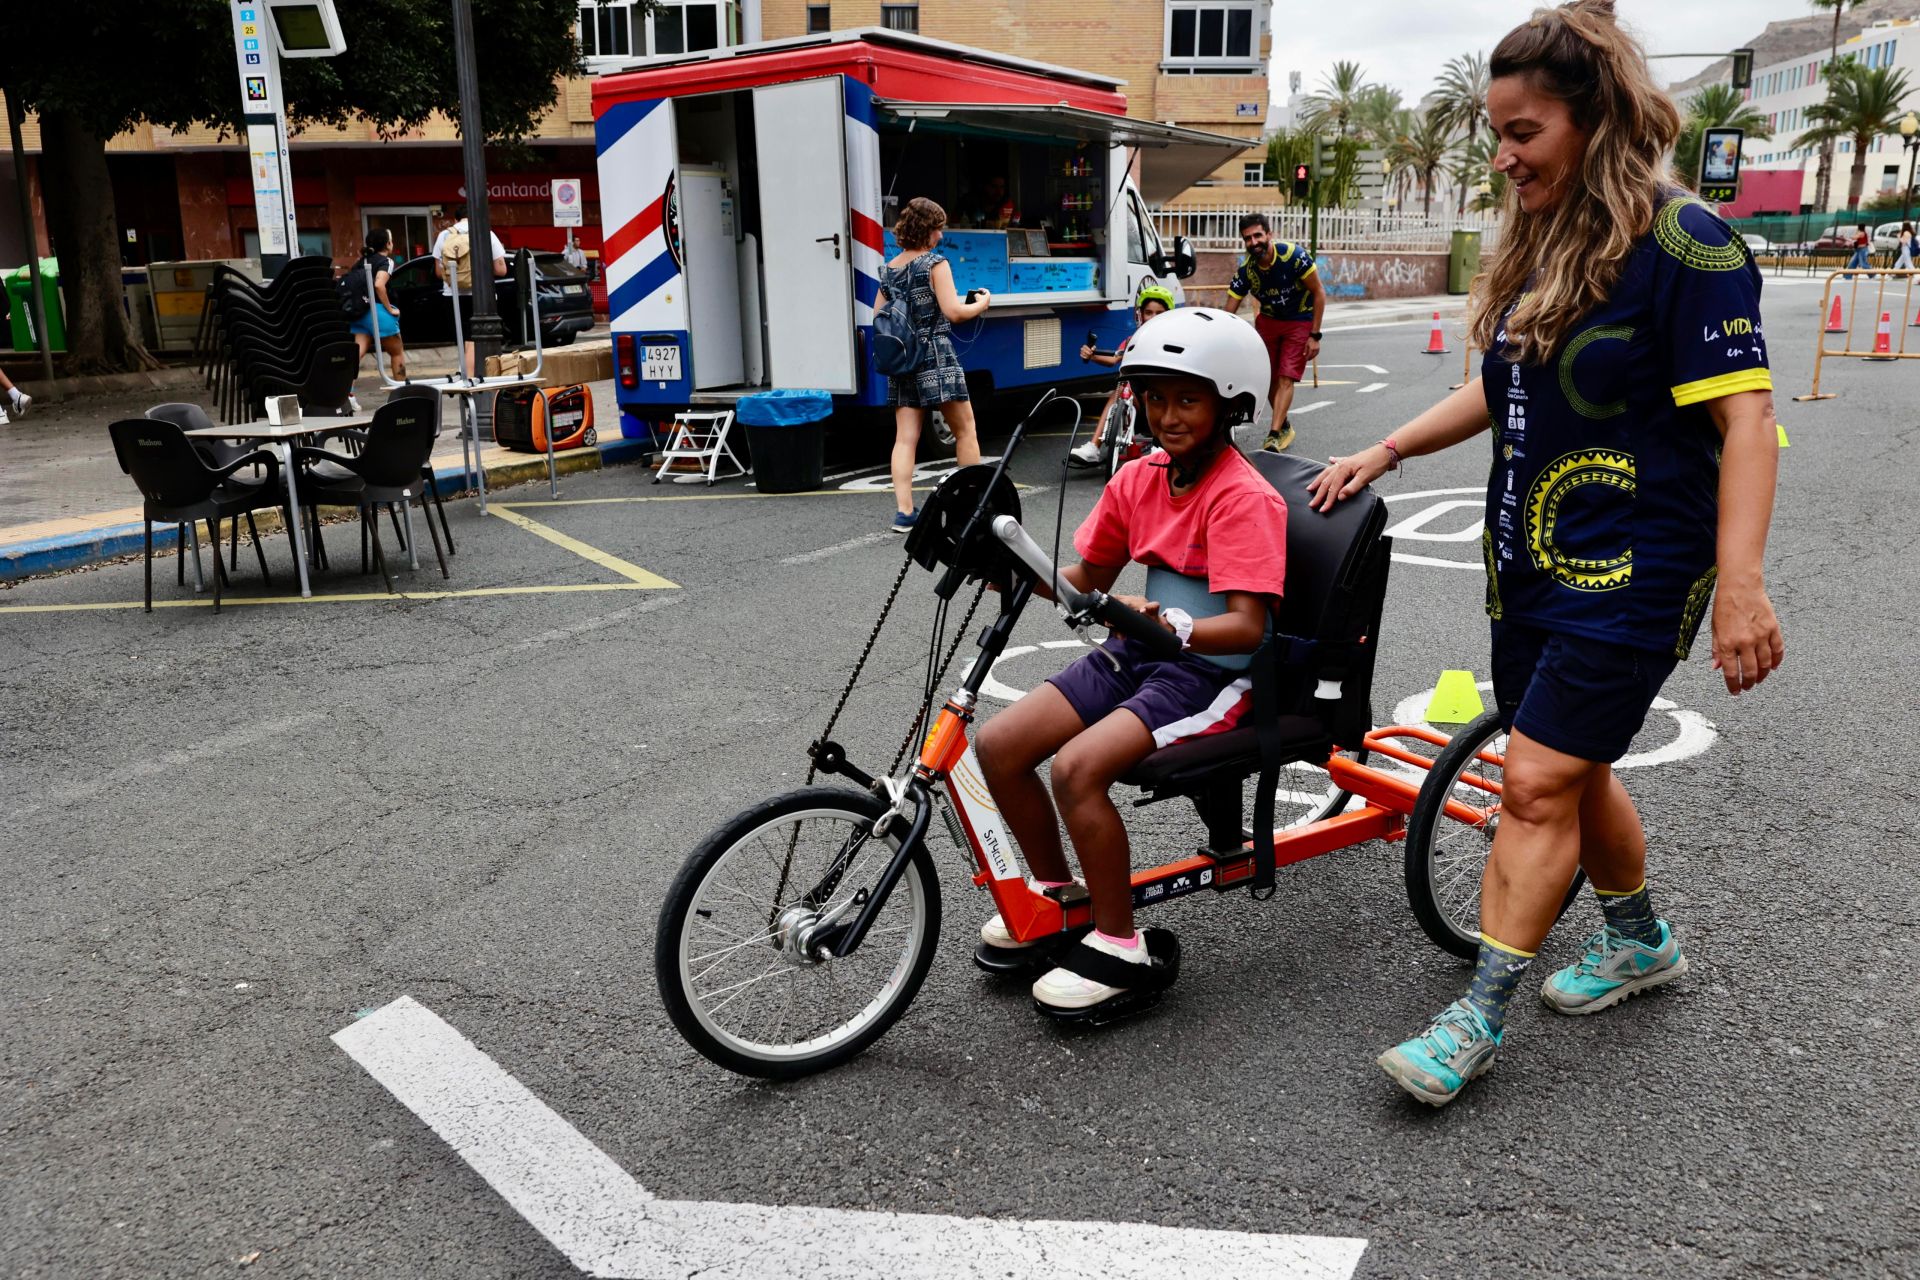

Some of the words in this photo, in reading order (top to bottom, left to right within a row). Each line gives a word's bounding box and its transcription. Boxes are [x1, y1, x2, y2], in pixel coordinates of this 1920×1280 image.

[245, 26, 254, 35] 25
[248, 55, 258, 64] L3
[486, 182, 553, 198] antand
[1704, 325, 1720, 342] La
[1723, 317, 1752, 337] VIDA
[648, 347, 677, 361] 4927
[1727, 348, 1743, 357] en
[649, 365, 673, 378] HYY
